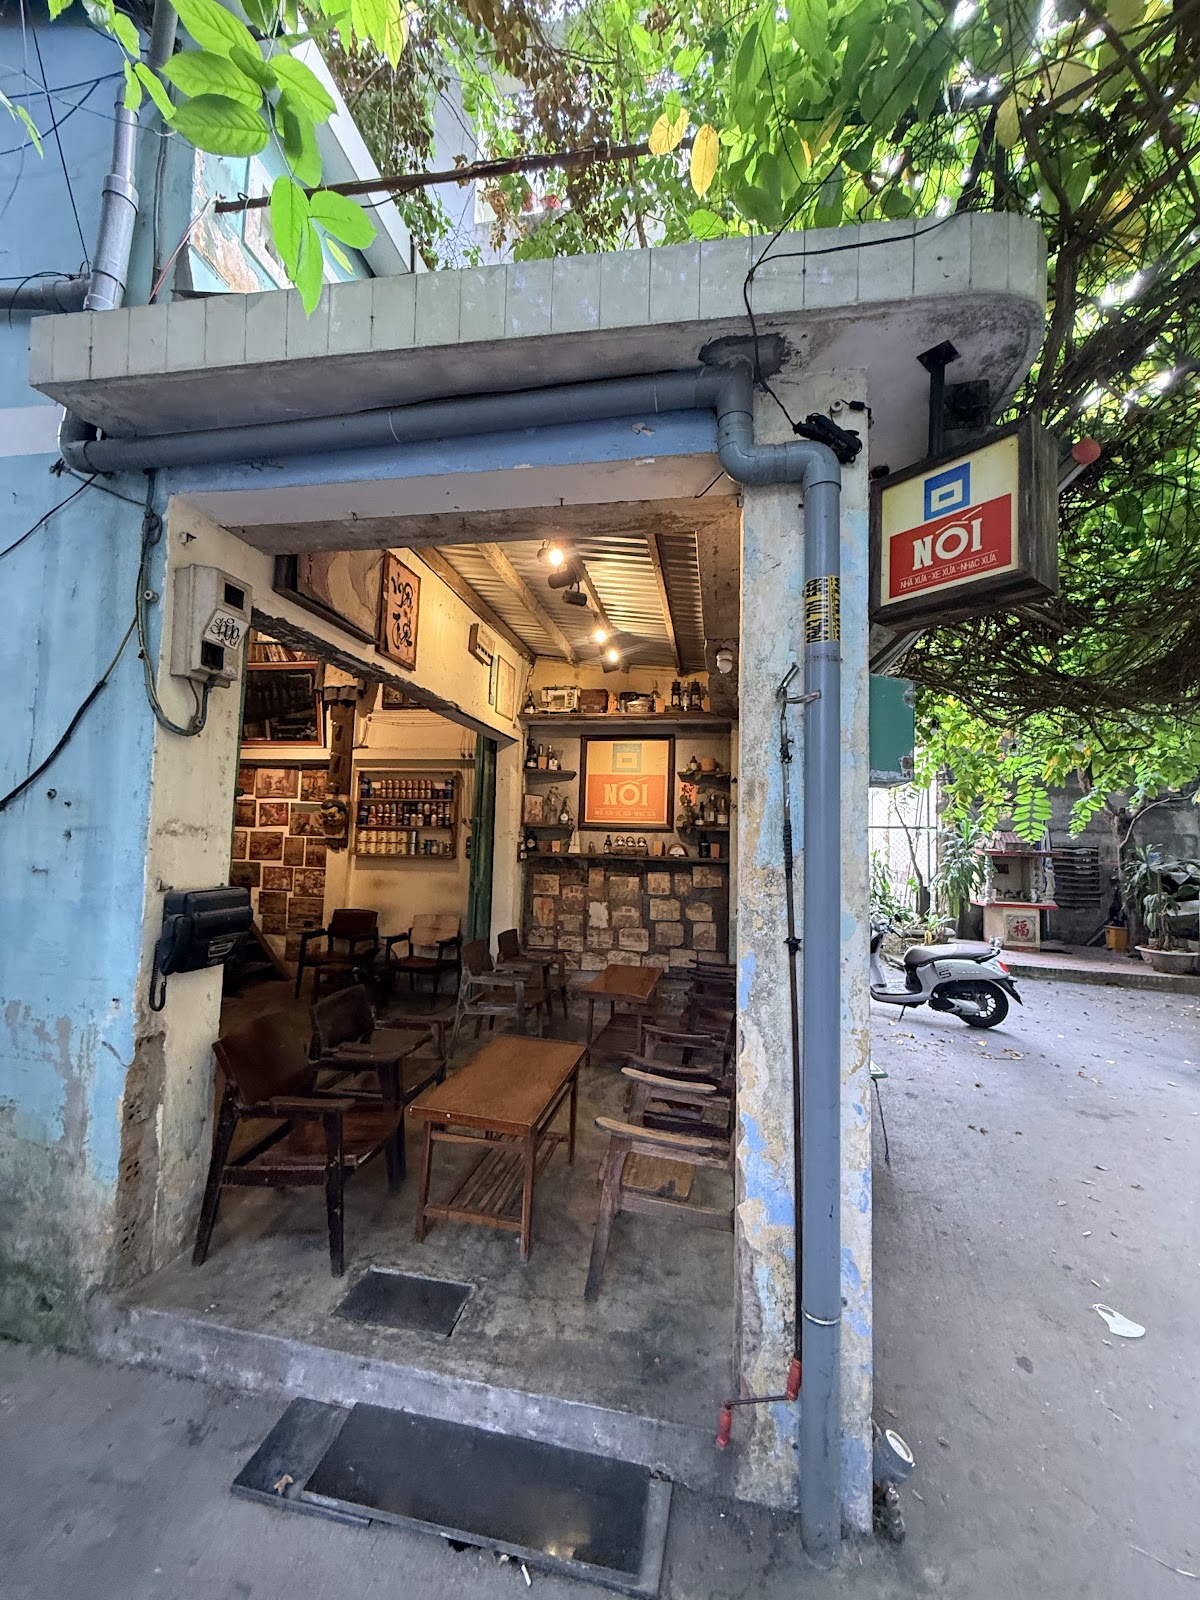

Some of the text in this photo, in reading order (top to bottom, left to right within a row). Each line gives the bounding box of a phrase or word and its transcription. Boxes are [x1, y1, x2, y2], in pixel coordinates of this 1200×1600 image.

[914, 573, 928, 586] XƯA
[931, 570, 941, 580] XE
[942, 565, 957, 577] XƯA
[960, 558, 980, 571] NHẠC
[981, 553, 997, 565] XƯA
[1012, 919, 1030, 938] 福
